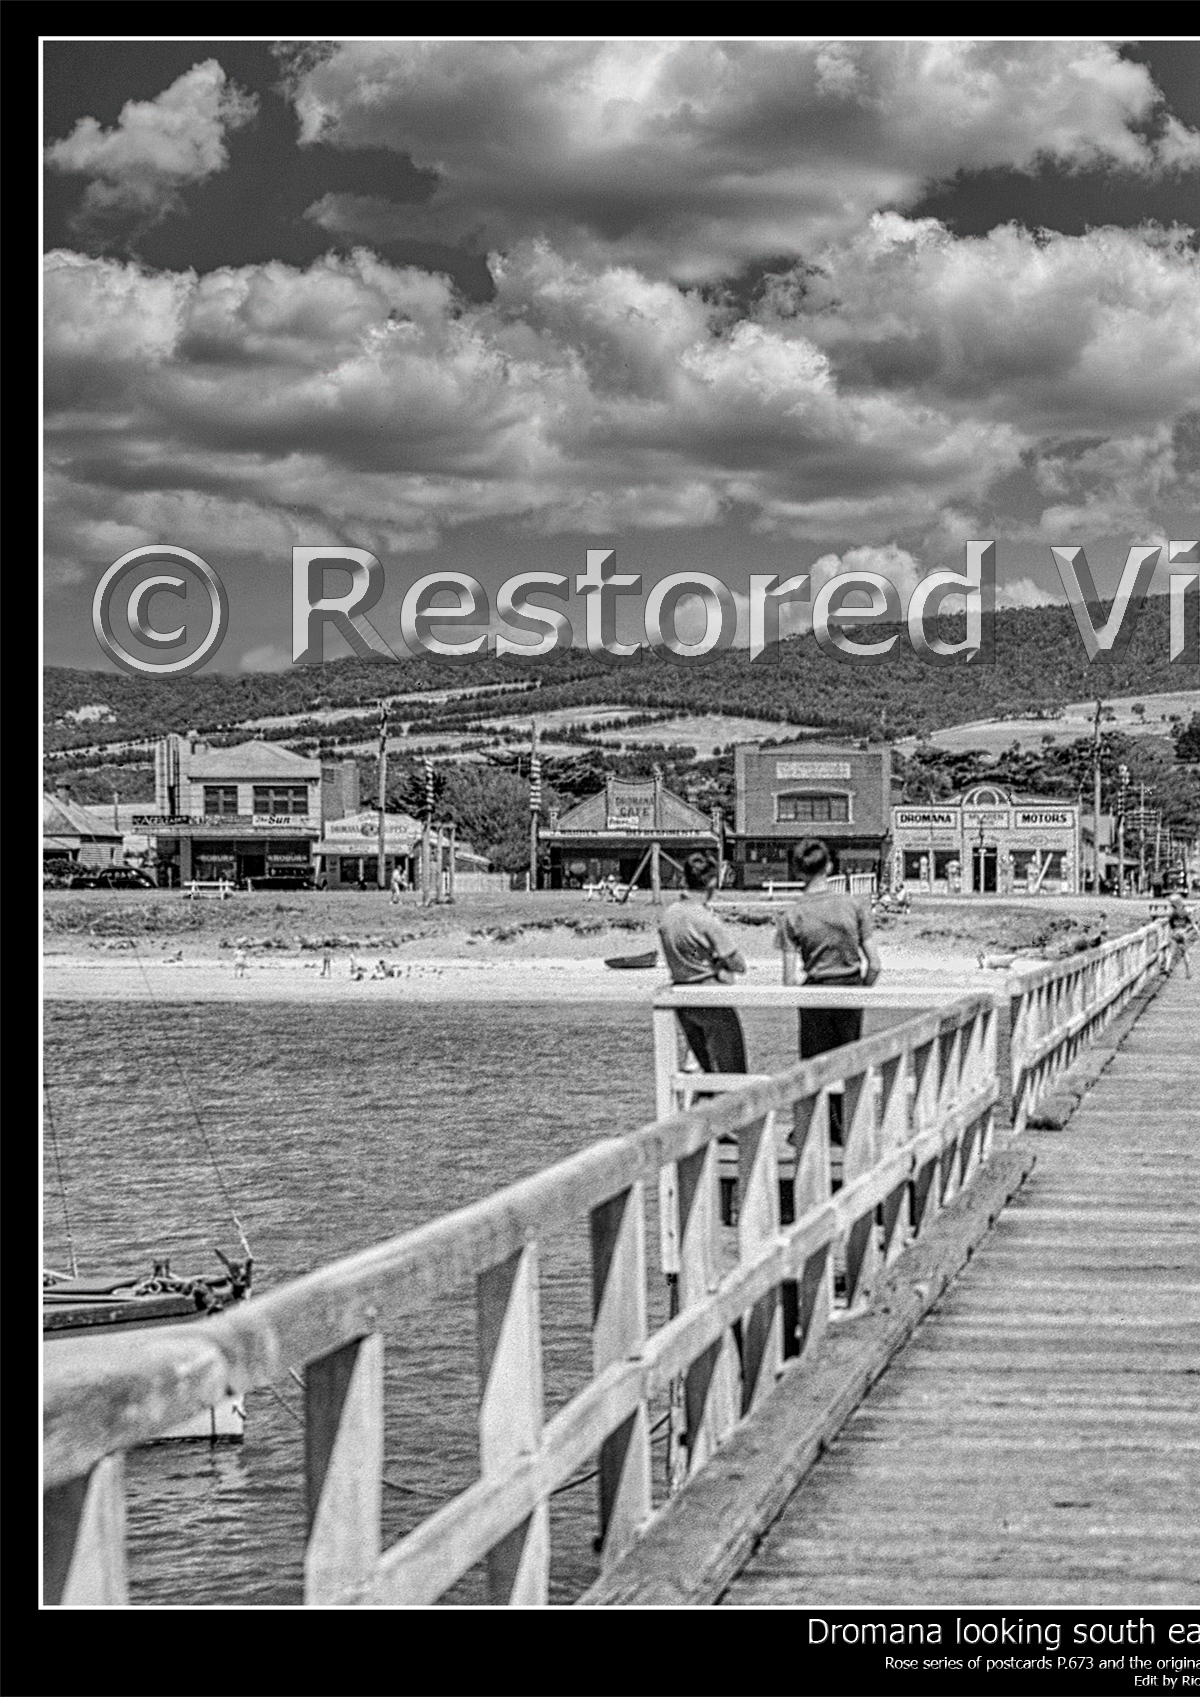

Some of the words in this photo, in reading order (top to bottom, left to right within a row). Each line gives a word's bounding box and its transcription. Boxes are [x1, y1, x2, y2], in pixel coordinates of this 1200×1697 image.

[615, 797, 655, 806] DROMANA
[620, 807, 650, 817] CAFE
[268, 815, 291, 825] Sun
[900, 814, 951, 824] DROMANA
[1022, 814, 1067, 824] MOTORS
